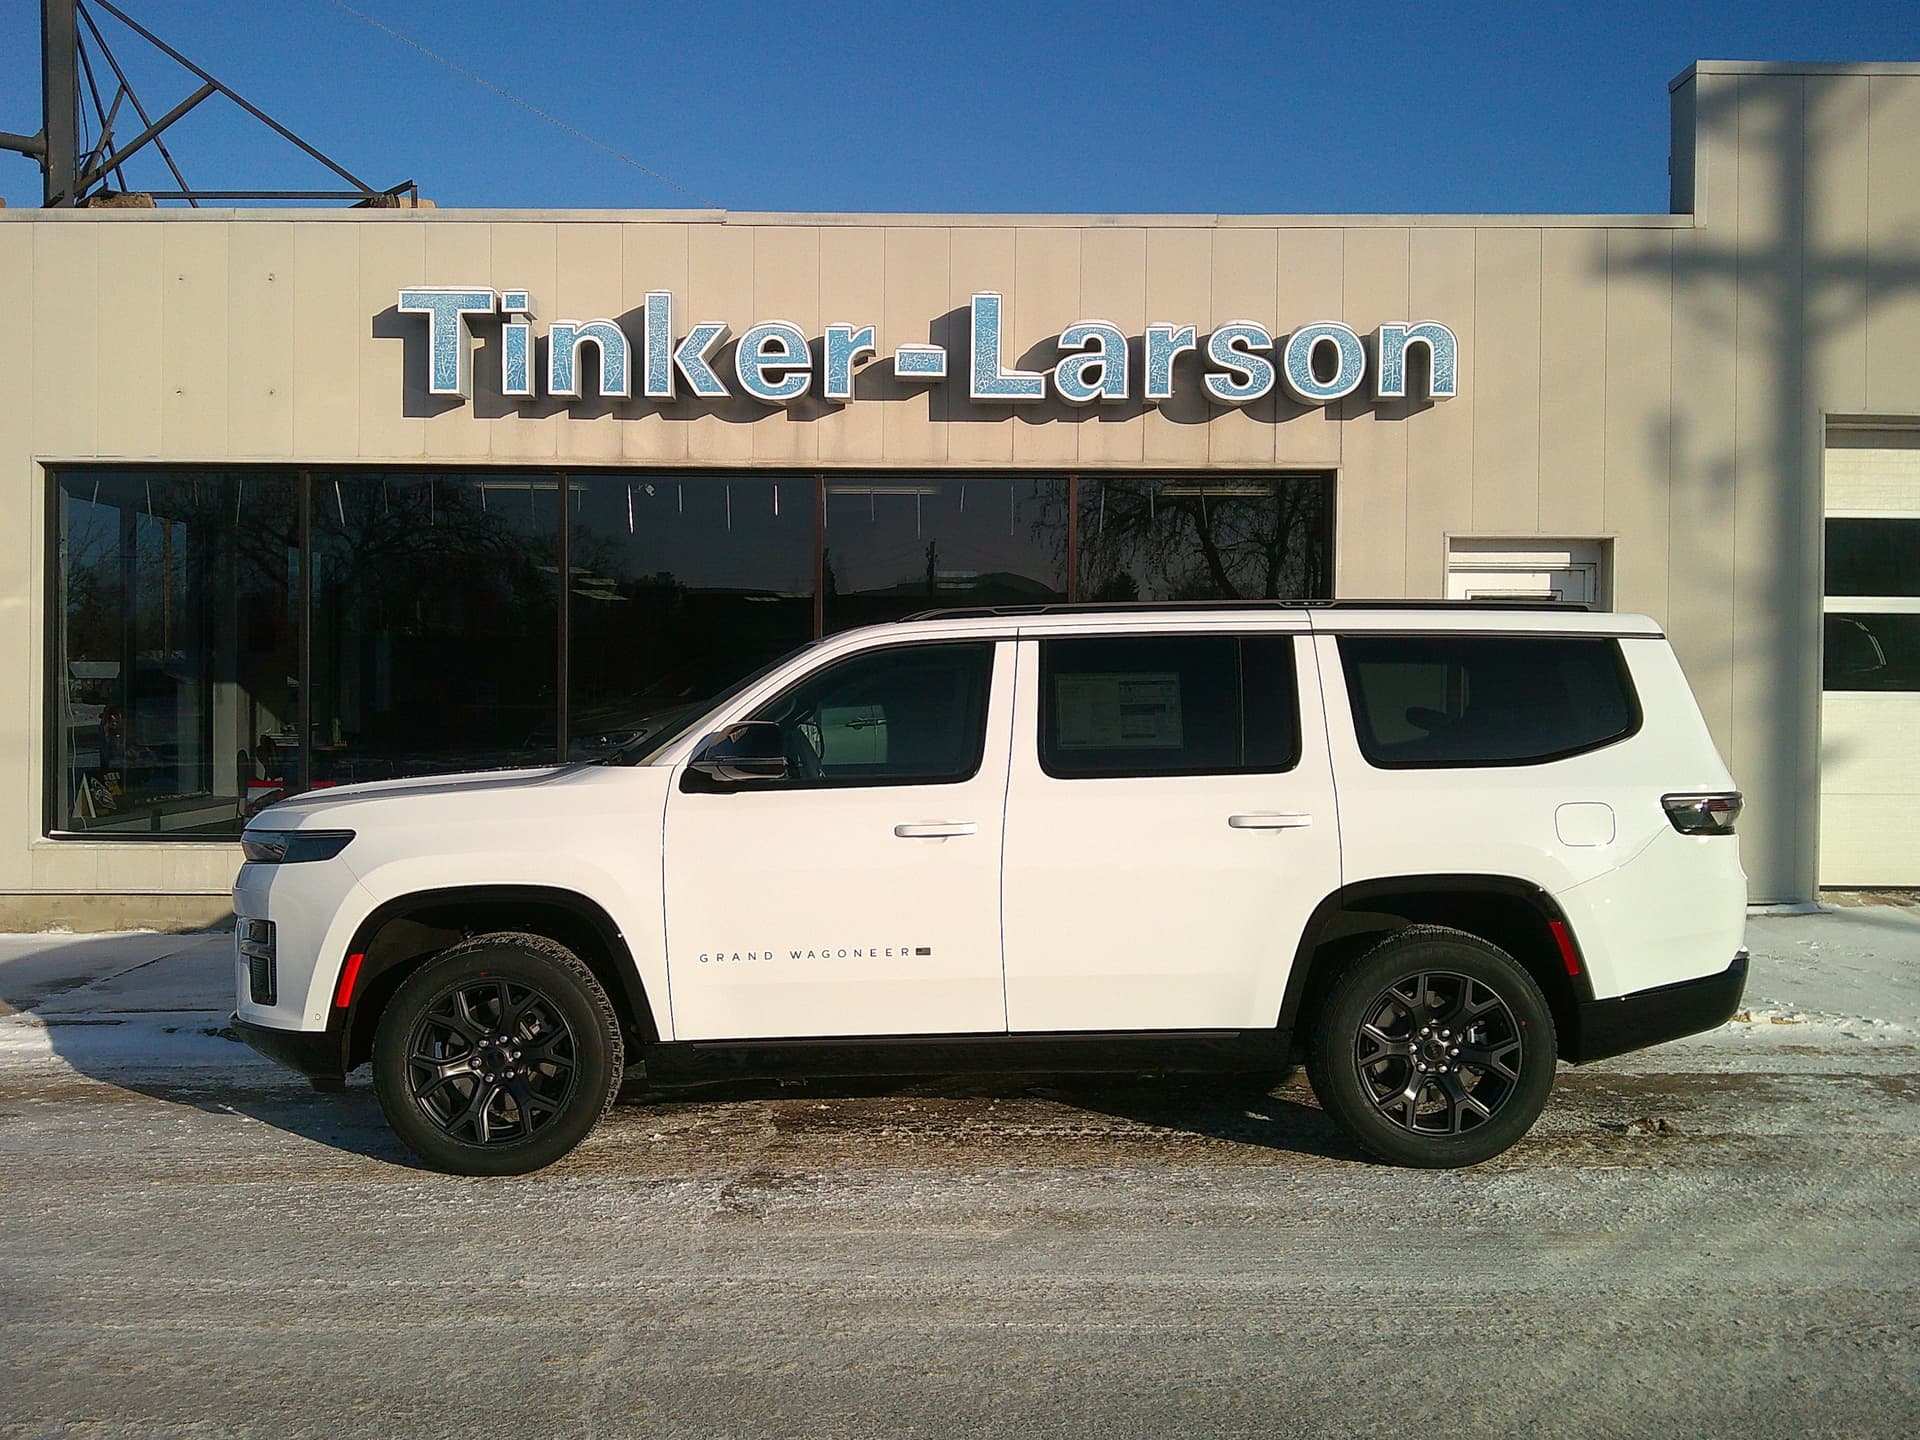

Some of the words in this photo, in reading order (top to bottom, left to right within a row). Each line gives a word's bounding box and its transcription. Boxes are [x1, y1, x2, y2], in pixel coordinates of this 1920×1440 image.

[397, 287, 1459, 403] Tinker-Larson
[699, 951, 773, 963] GRAND
[789, 947, 909, 960] WAGONEER
